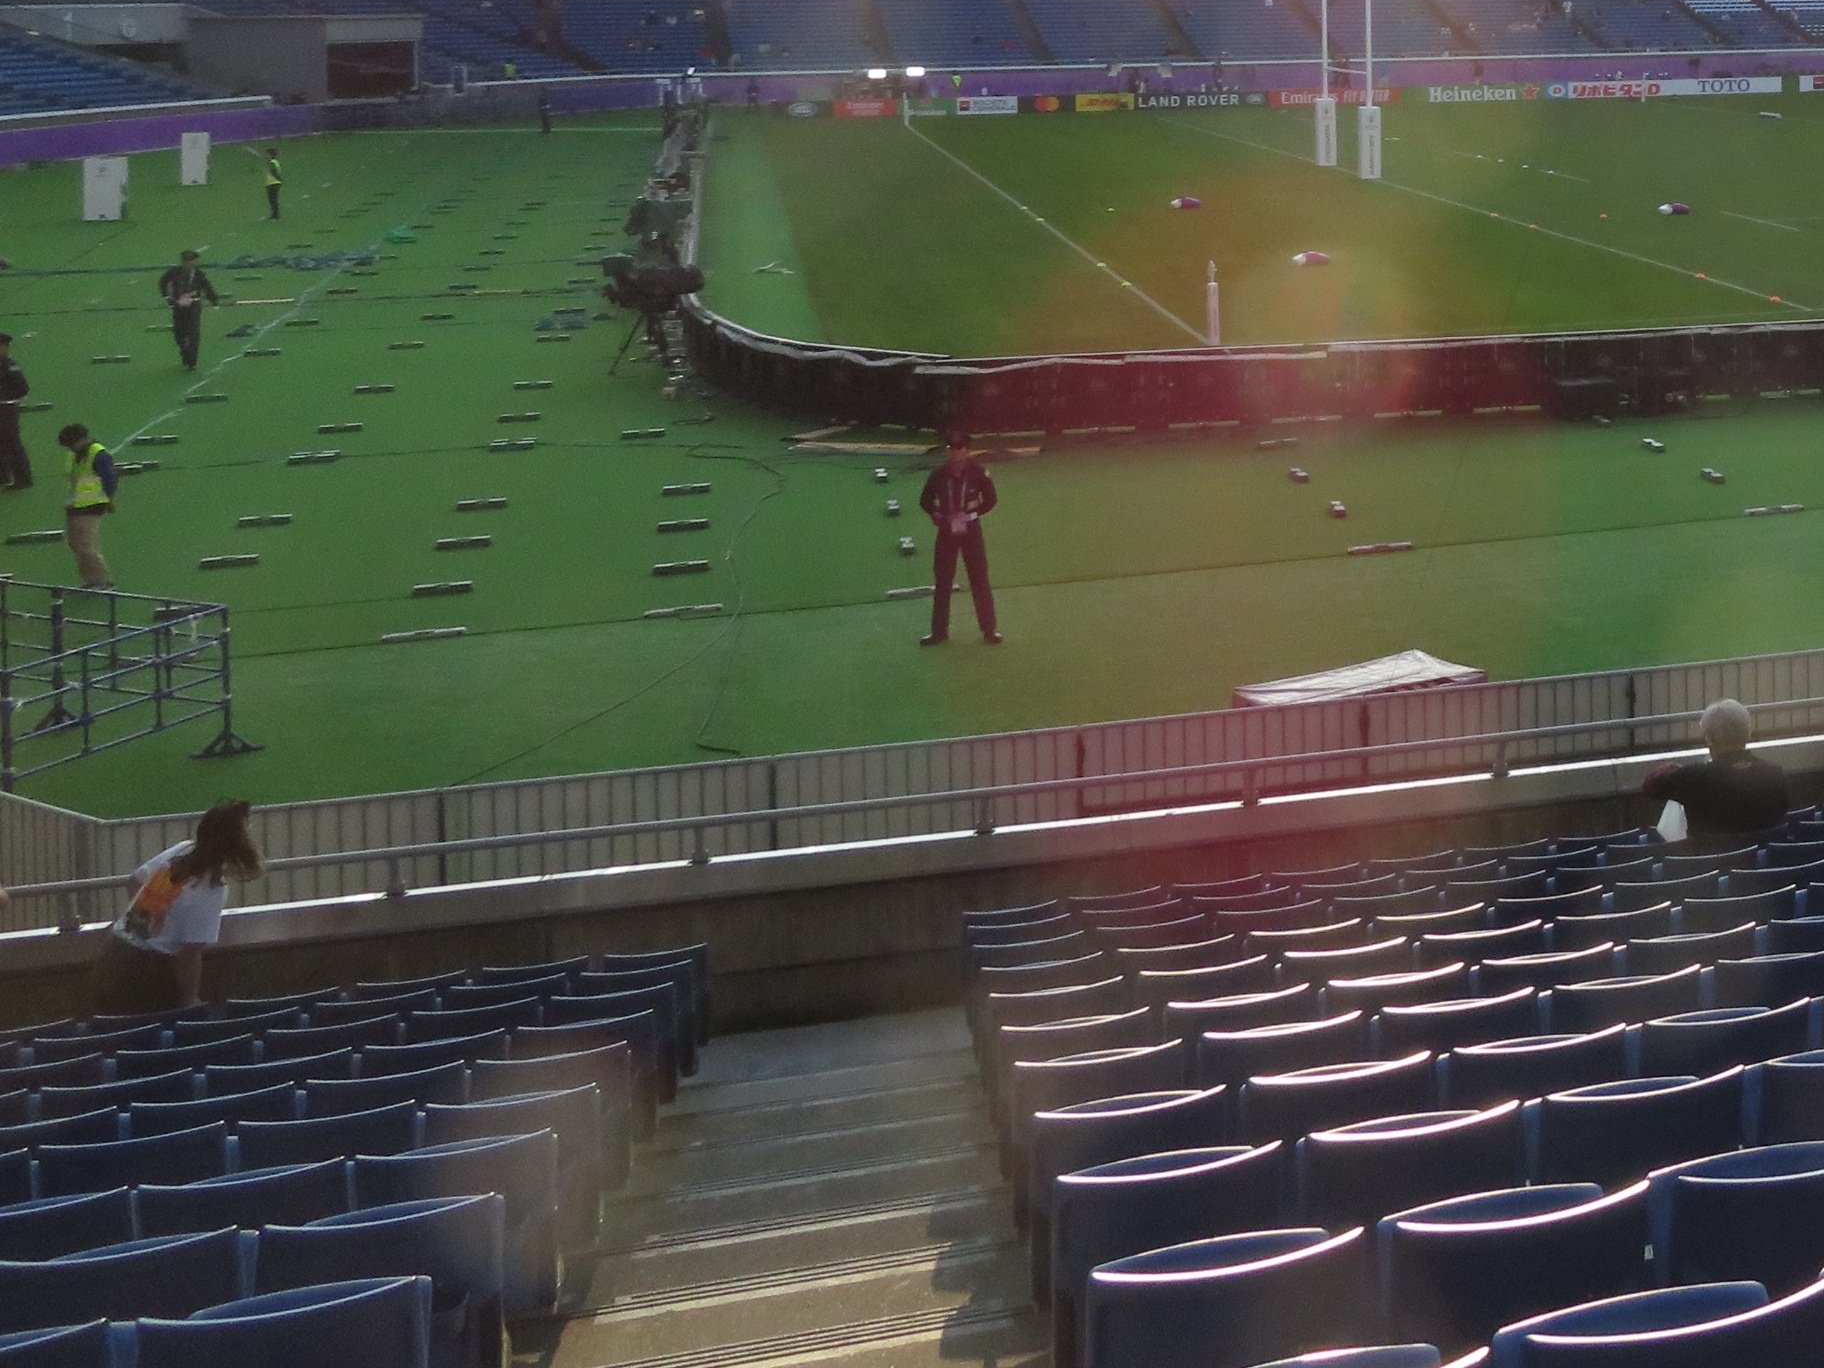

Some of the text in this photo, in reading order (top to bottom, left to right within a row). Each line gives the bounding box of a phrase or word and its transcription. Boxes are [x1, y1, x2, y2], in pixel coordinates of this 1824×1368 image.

[1698, 78, 1750, 93] TOTO
[1138, 95, 1181, 108] LAND
[1186, 94, 1240, 107] ROVER
[1281, 91, 1339, 105] Emirs
[1429, 85, 1517, 103] Heineken
